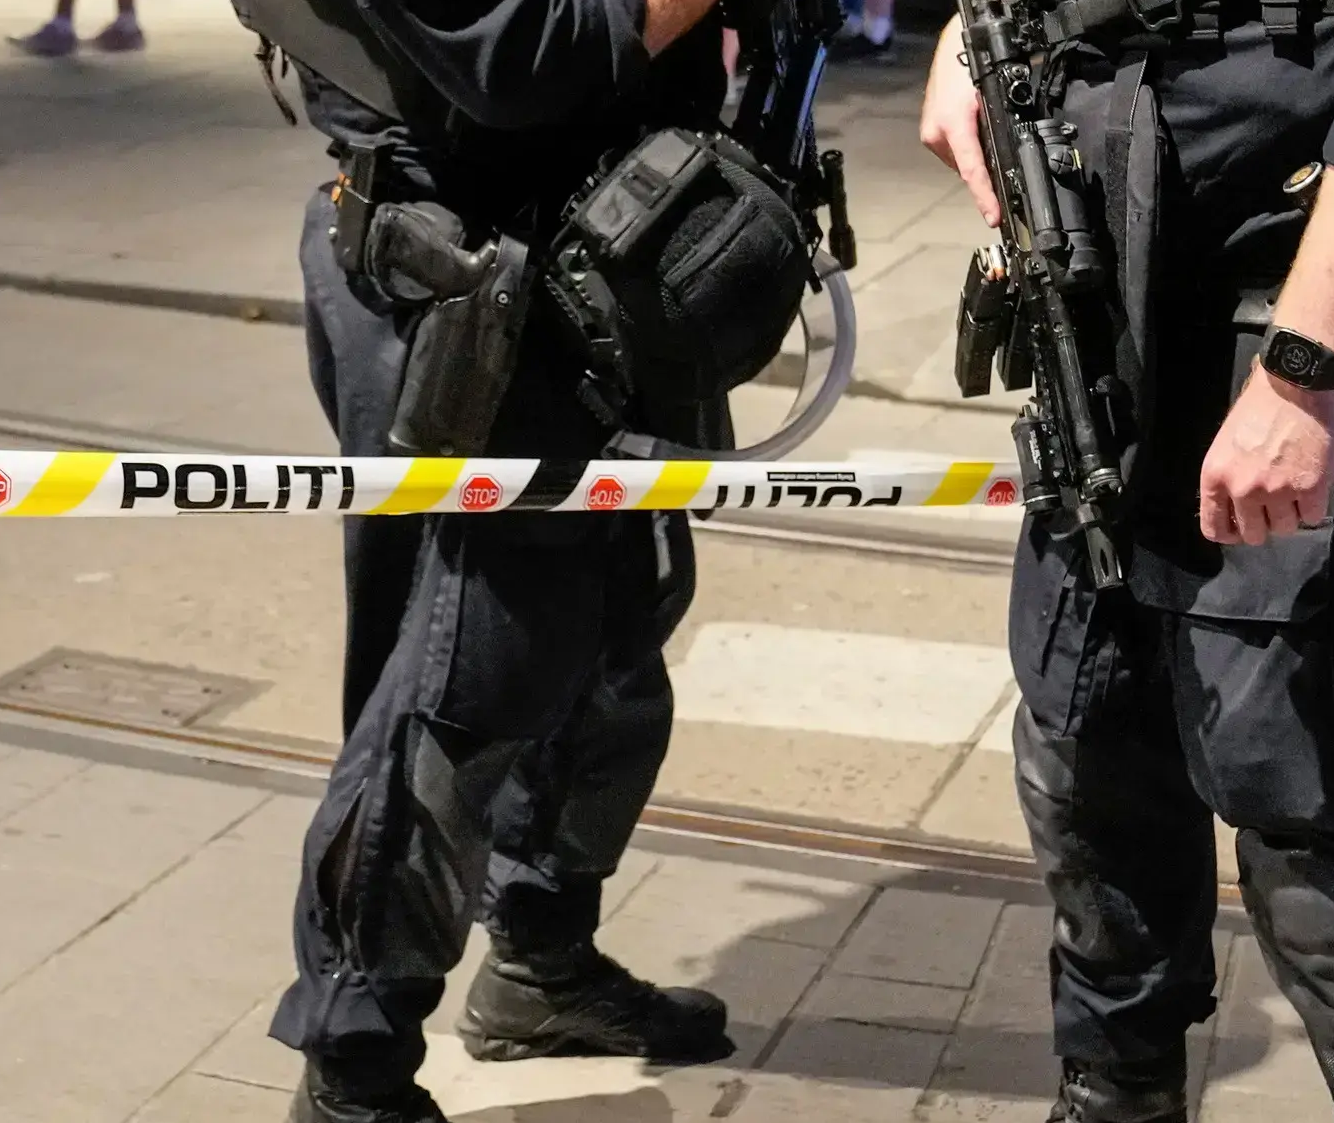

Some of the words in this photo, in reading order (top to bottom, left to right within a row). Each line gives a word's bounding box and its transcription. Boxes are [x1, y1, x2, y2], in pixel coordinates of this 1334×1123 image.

[120, 463, 354, 510] POLITI
[464, 488, 497, 506] STOP
[588, 490, 622, 506] STOP
